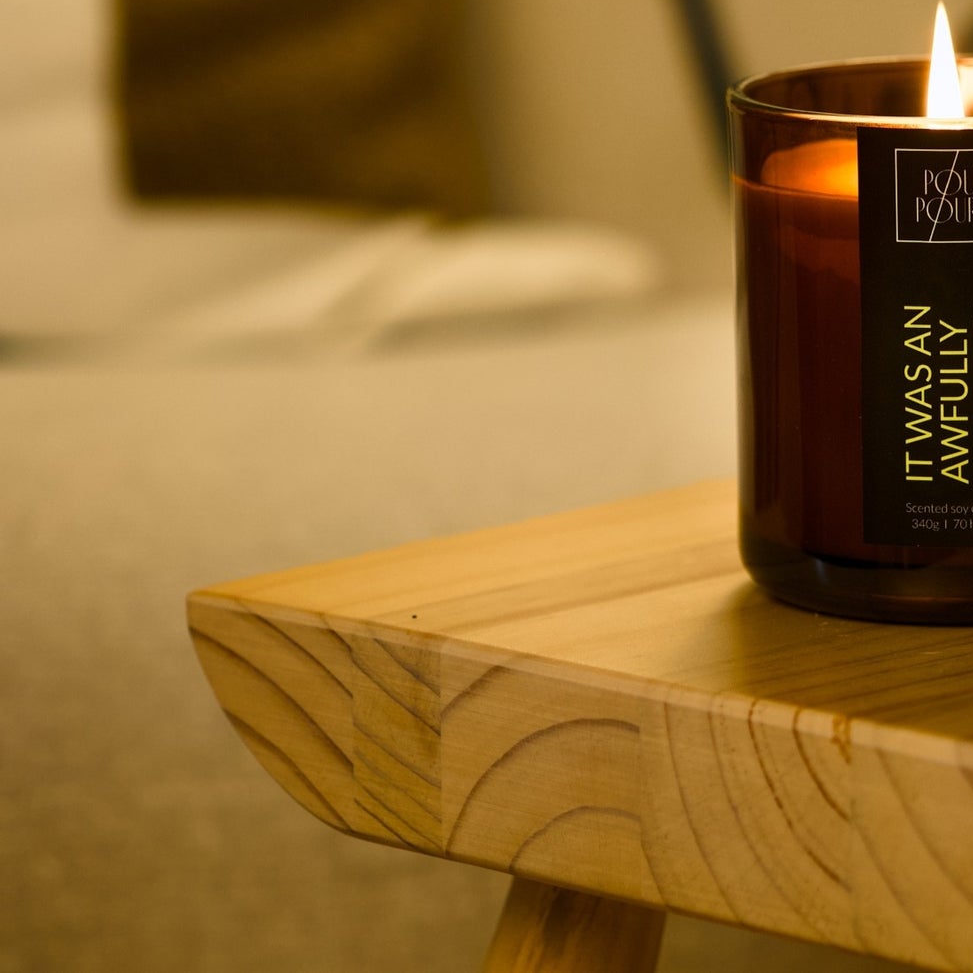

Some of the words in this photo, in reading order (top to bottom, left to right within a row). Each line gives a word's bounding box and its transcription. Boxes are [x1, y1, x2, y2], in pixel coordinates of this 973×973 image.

[904, 305, 931, 356] AN
[904, 364, 932, 444] WAS
[939, 319, 968, 484] AWFULLY
[905, 451, 933, 481] IT
[905, 502, 948, 514] Scented
[950, 505, 969, 515] soy
[911, 518, 939, 531] 340g
[953, 518, 968, 529] 70
